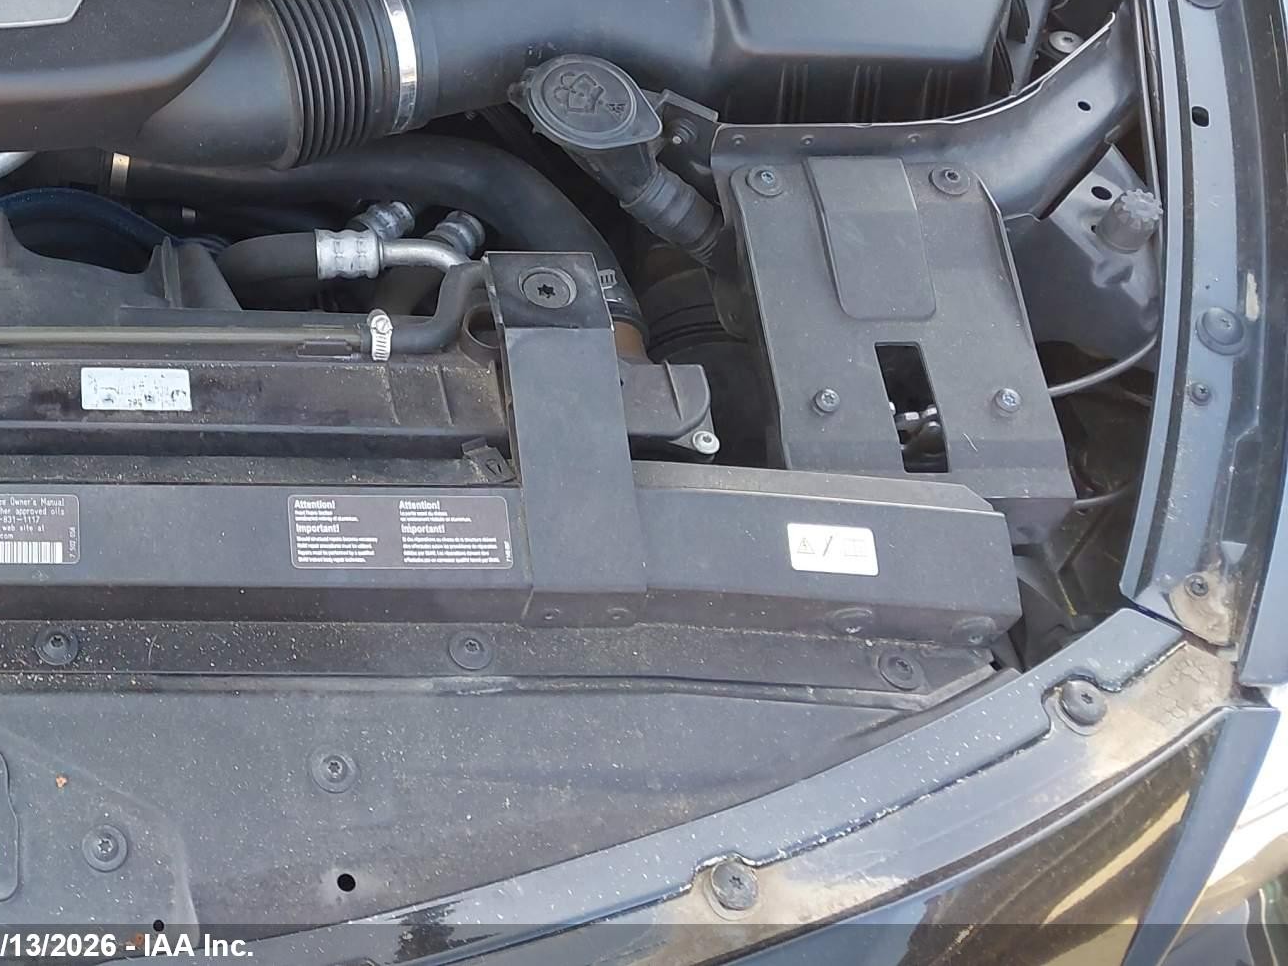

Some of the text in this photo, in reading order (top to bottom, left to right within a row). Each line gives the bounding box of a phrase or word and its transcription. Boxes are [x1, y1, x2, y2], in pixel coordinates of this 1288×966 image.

[10, 496, 37, 506] Owner's
[40, 497, 65, 507] Manual
[294, 499, 336, 510] Attention!
[399, 499, 440, 510] Attention!
[15, 506, 47, 516] approved
[51, 505, 65, 516] oils
[2, 523, 16, 532] web
[37, 523, 45, 532] at
[295, 523, 340, 534] Important!
[401, 524, 445, 535] Important!
